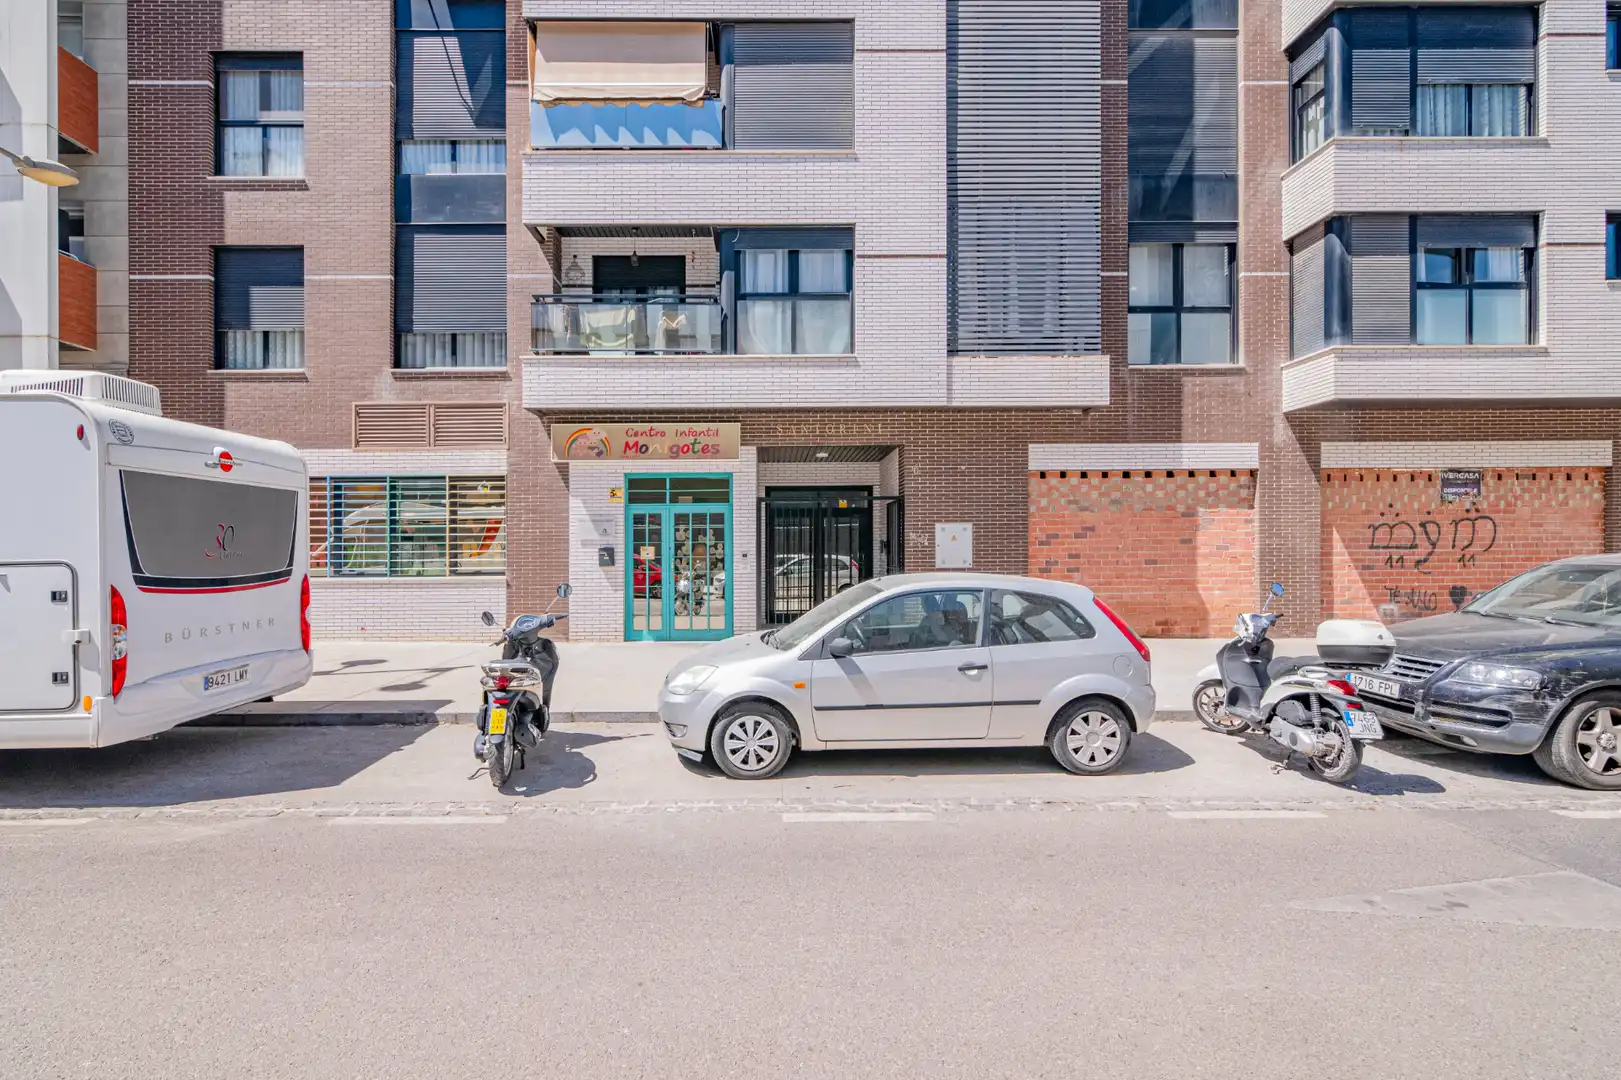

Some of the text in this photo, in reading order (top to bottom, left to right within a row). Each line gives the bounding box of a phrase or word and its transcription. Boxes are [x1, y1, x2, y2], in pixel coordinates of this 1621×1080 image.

[625, 426, 719, 438] Centro Infantil
[776, 424, 882, 435] SANTORINI
[623, 438, 720, 459] Monigotes
[164, 617, 276, 644] BÜRSTNER
[208, 668, 248, 688] 9421 LMY
[1354, 675, 1397, 696] 1716 FPL
[1360, 722, 1377, 733] JNG
